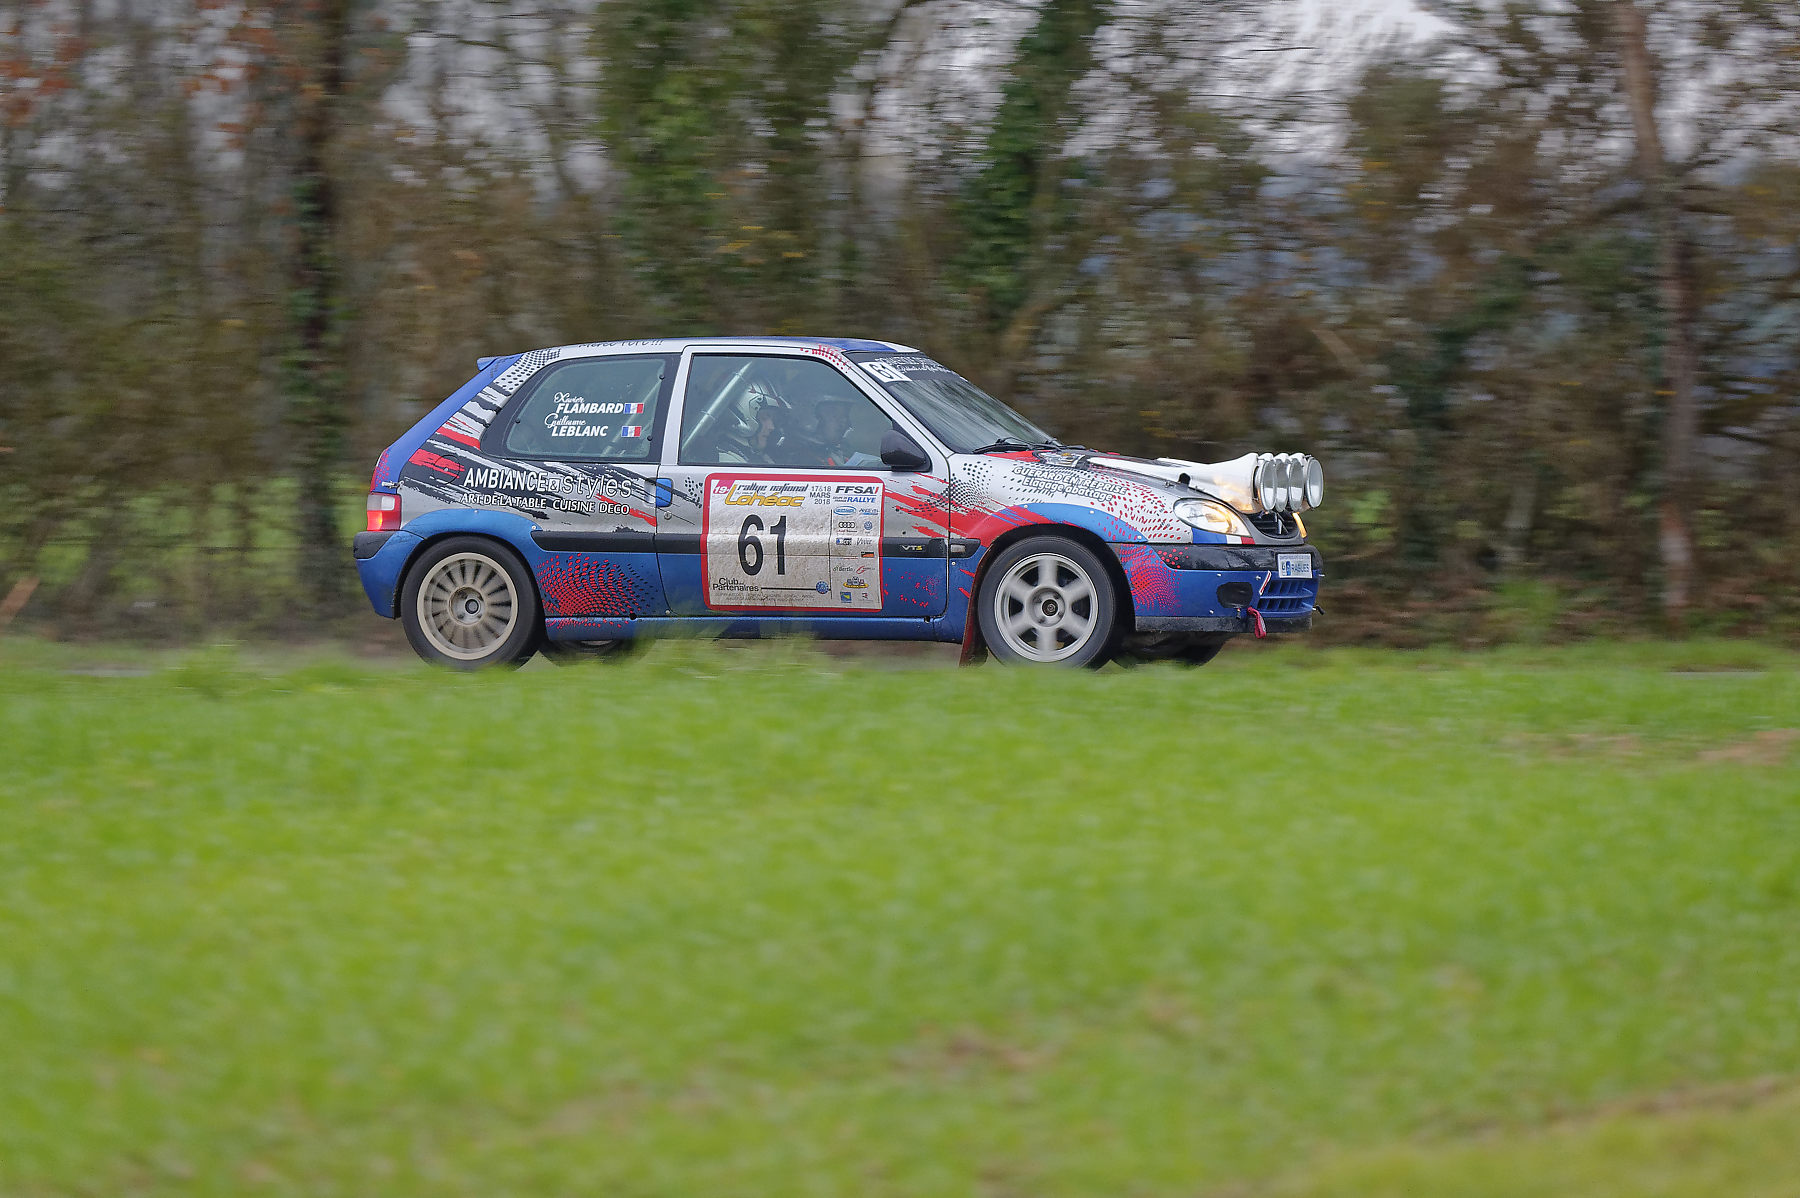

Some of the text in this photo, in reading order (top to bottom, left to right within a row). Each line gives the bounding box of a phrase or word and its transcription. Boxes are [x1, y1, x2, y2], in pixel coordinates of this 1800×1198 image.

[553, 391, 585, 403] Xavier
[556, 402, 624, 414] FLAMBARD
[544, 412, 587, 428] Guillaume
[551, 425, 609, 437] LEBLANC
[463, 467, 549, 492] AMBIANCE
[1013, 465, 1127, 495] GUERARD ENTREPRISE
[737, 482, 809, 494] rallye national
[835, 485, 874, 495] FFSA
[1022, 476, 1113, 502] Elagage abattage
[725, 484, 806, 507] Lohéac
[460, 493, 631, 515] ART DE LA TABLE CUISINE DECO
[738, 514, 787, 576] 61
[712, 584, 760, 592] Partenaires
[718, 577, 738, 585] Club
